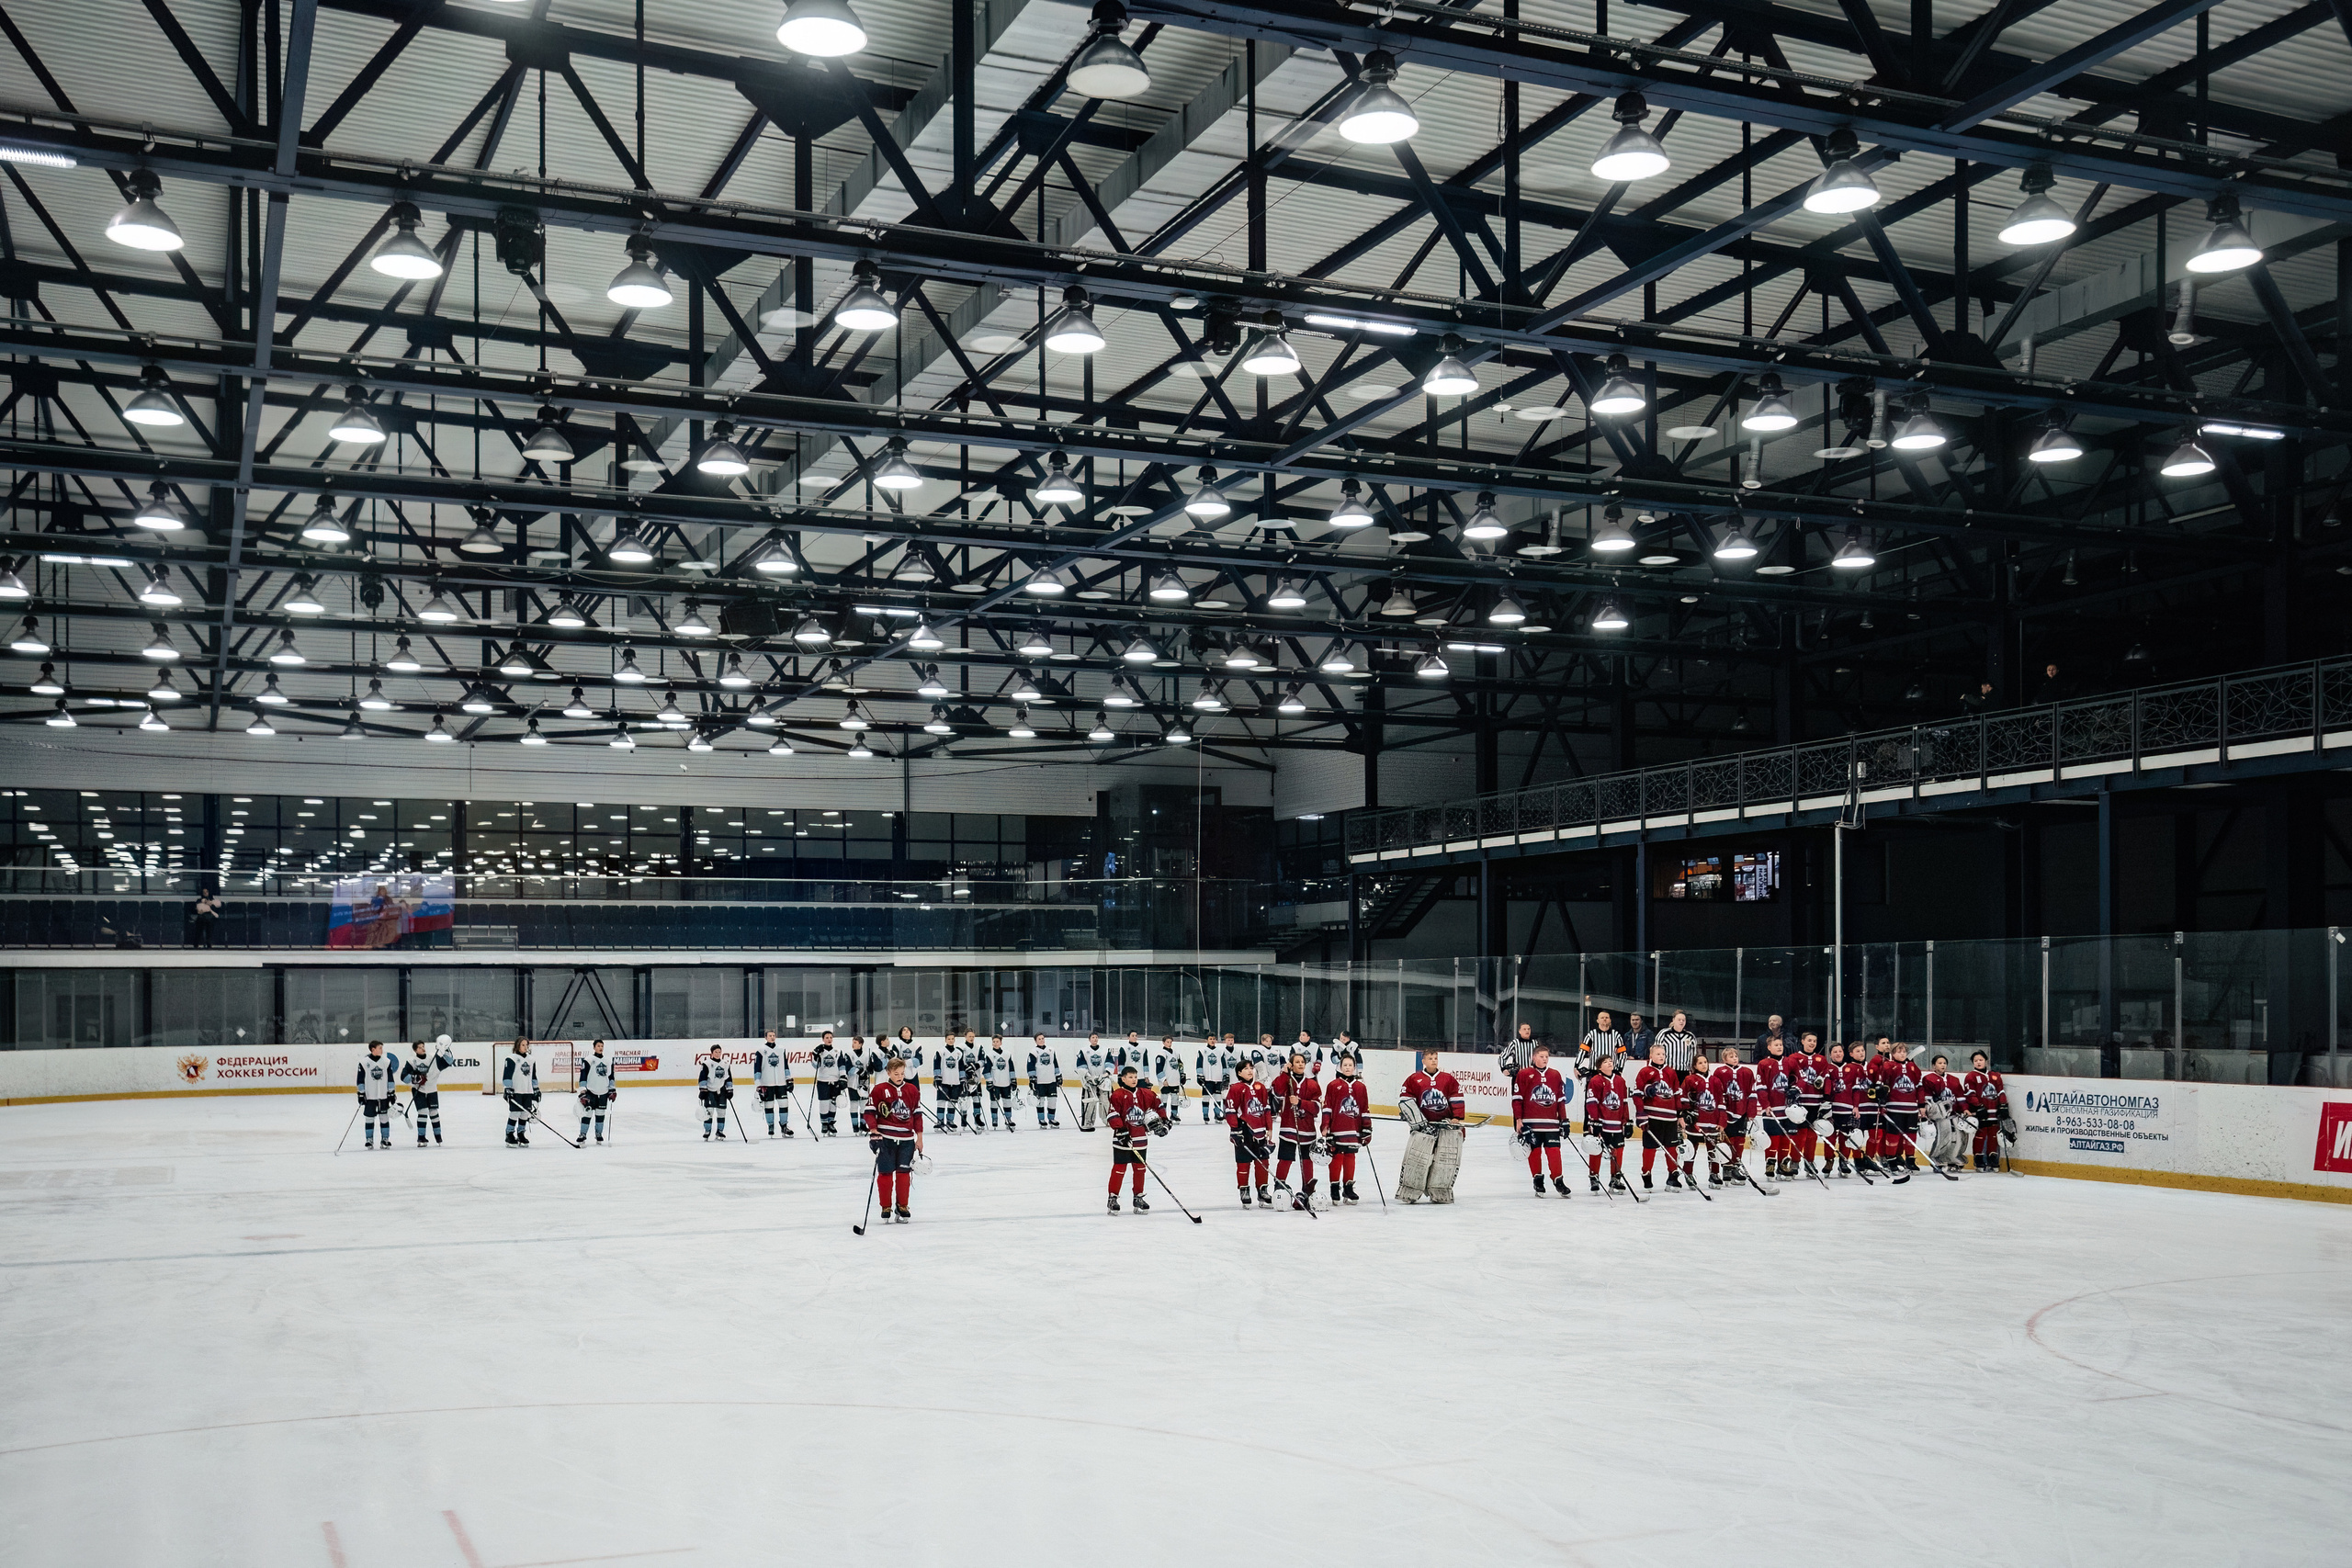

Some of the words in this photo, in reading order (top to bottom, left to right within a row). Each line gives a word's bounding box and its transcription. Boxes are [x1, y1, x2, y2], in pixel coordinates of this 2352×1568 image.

[217, 1056, 288, 1067] ФЕДЕРАЦИЯ
[452, 1058, 481, 1067] КЕЛЬ
[695, 1053, 756, 1066] КРСНАЯ
[787, 1051, 813, 1064] ИНА
[217, 1068, 265, 1078] ХОККЕЯ
[268, 1067, 318, 1077] РОССИИ
[1451, 1070, 1491, 1083] ФЕДЕРАЦИЯ
[1478, 1086, 1508, 1097] РОССИИ
[1771, 1082, 1789, 1090] АЛТА
[1419, 1096, 1449, 1108] АЛТАЙ
[1530, 1092, 1556, 1101] АЛТАЙ
[2036, 1090, 2159, 1112] АЛТАЙАВТОНОМГАЗ
[1227, 1099, 1235, 1109] 12
[2100, 1108, 2159, 1119] ГАЗИФИКАЦИЯ
[2056, 1116, 2135, 1130] 8-963-533-08-08
[2025, 1124, 2049, 1133] ЖИЛЫЕ
[2057, 1127, 2131, 1139] ПРОИЗВОДСТВЕННЫЕ
[2132, 1132, 2169, 1141] ОБЪЕКТЫ
[2071, 1139, 2124, 1152] АЛТАЙГАЗ.РФ
[2333, 1121, 2352, 1159] И
